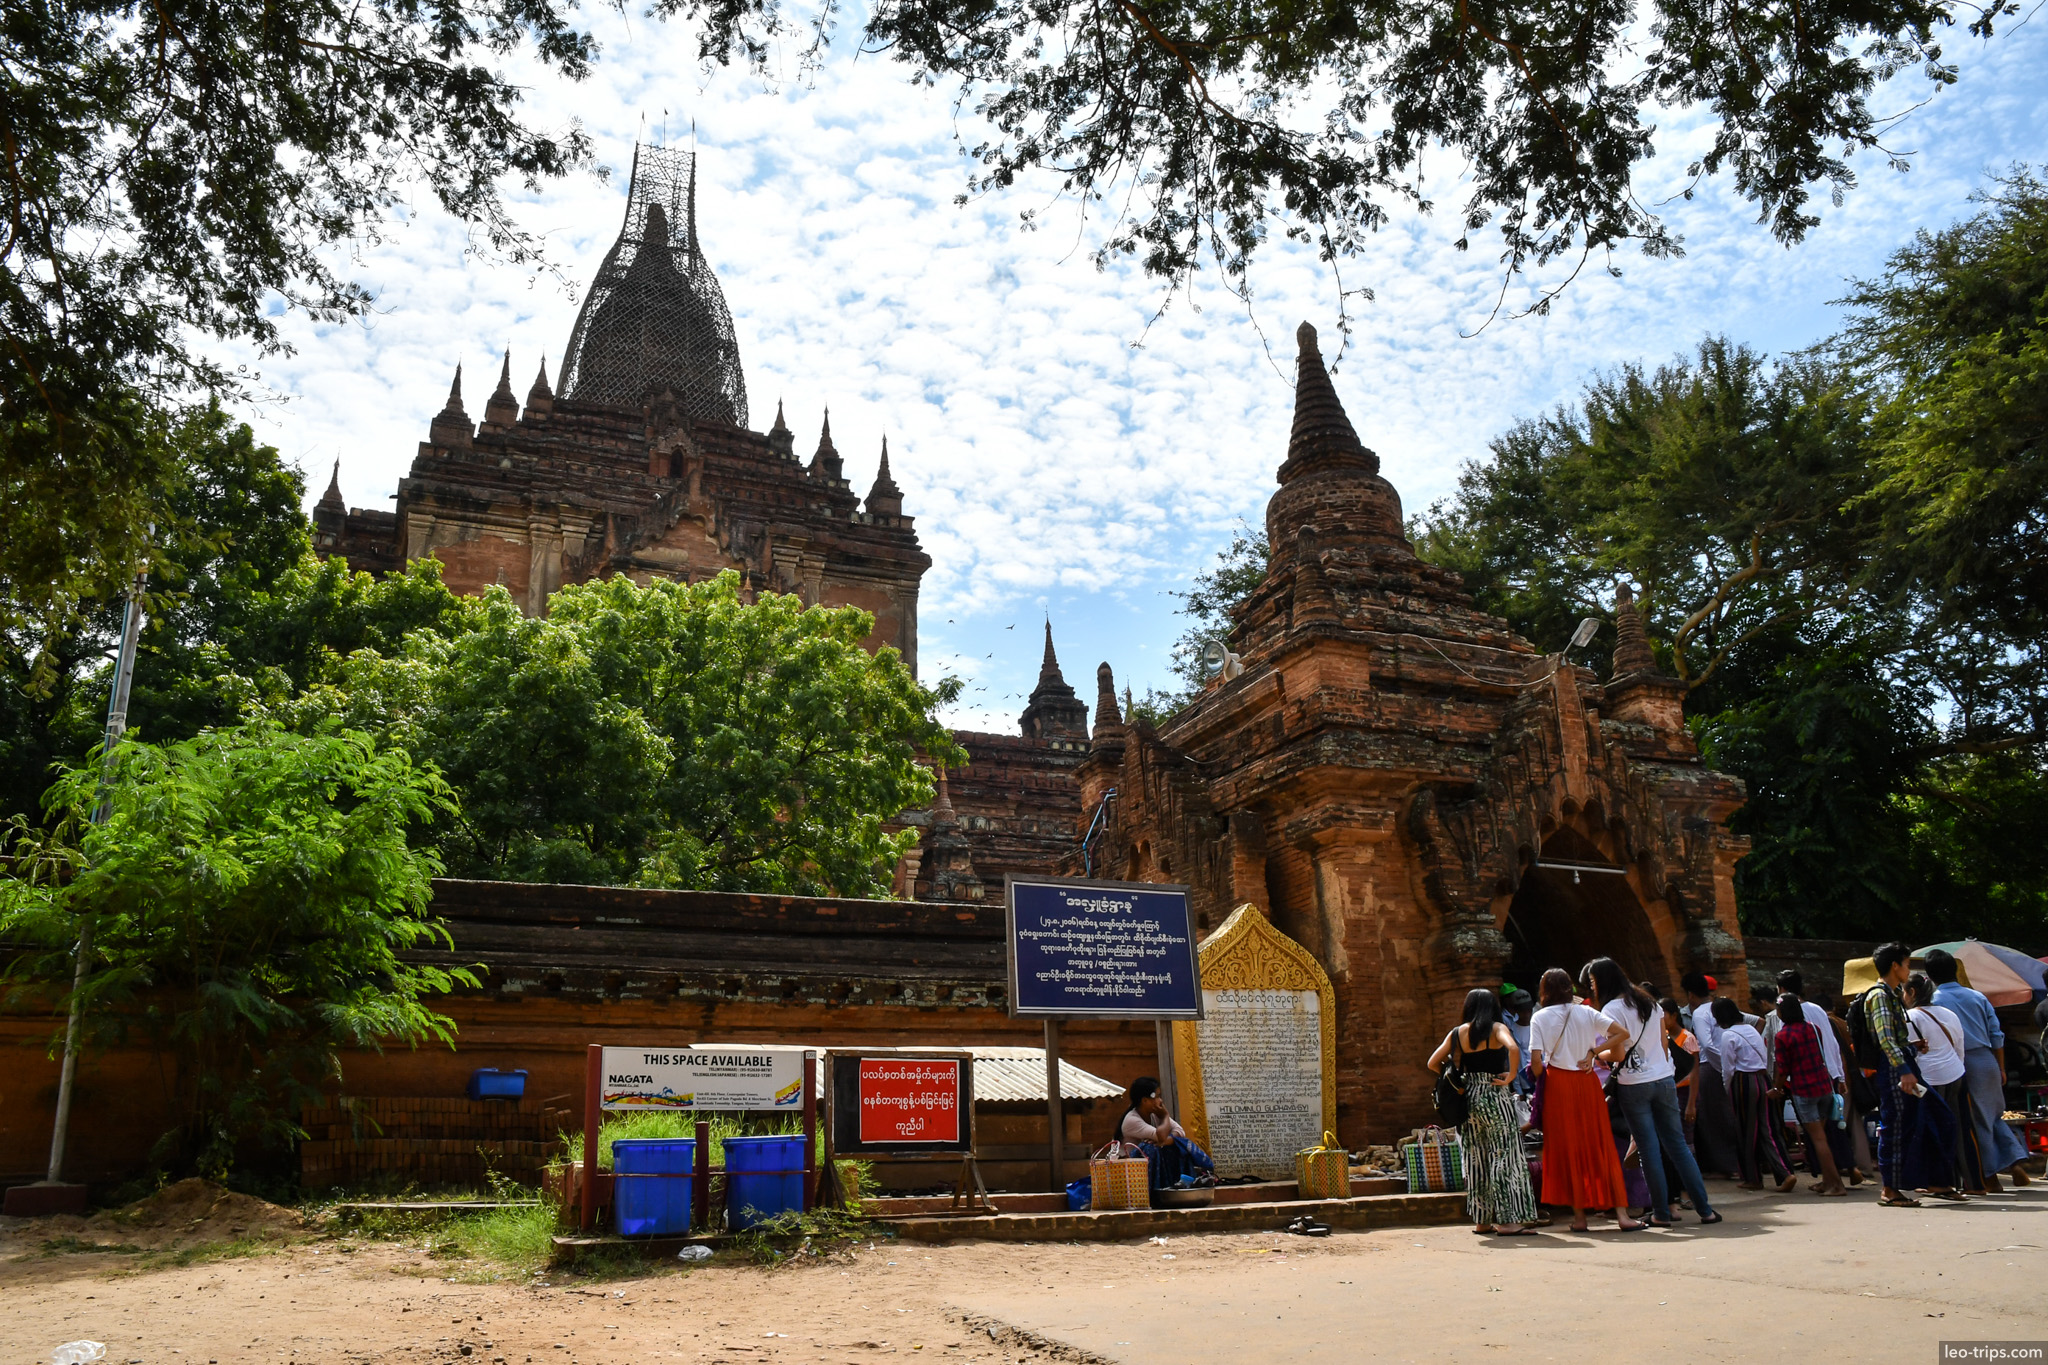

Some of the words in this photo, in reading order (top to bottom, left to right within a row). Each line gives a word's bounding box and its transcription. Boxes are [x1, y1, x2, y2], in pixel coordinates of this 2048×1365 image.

[644, 1054, 670, 1065] THIS
[672, 1054, 708, 1066] SPACE
[711, 1056, 773, 1067] AVAILABLE
[609, 1075, 653, 1083] NAGATA
[896, 1117, 924, 1135] ကူညီပါ
